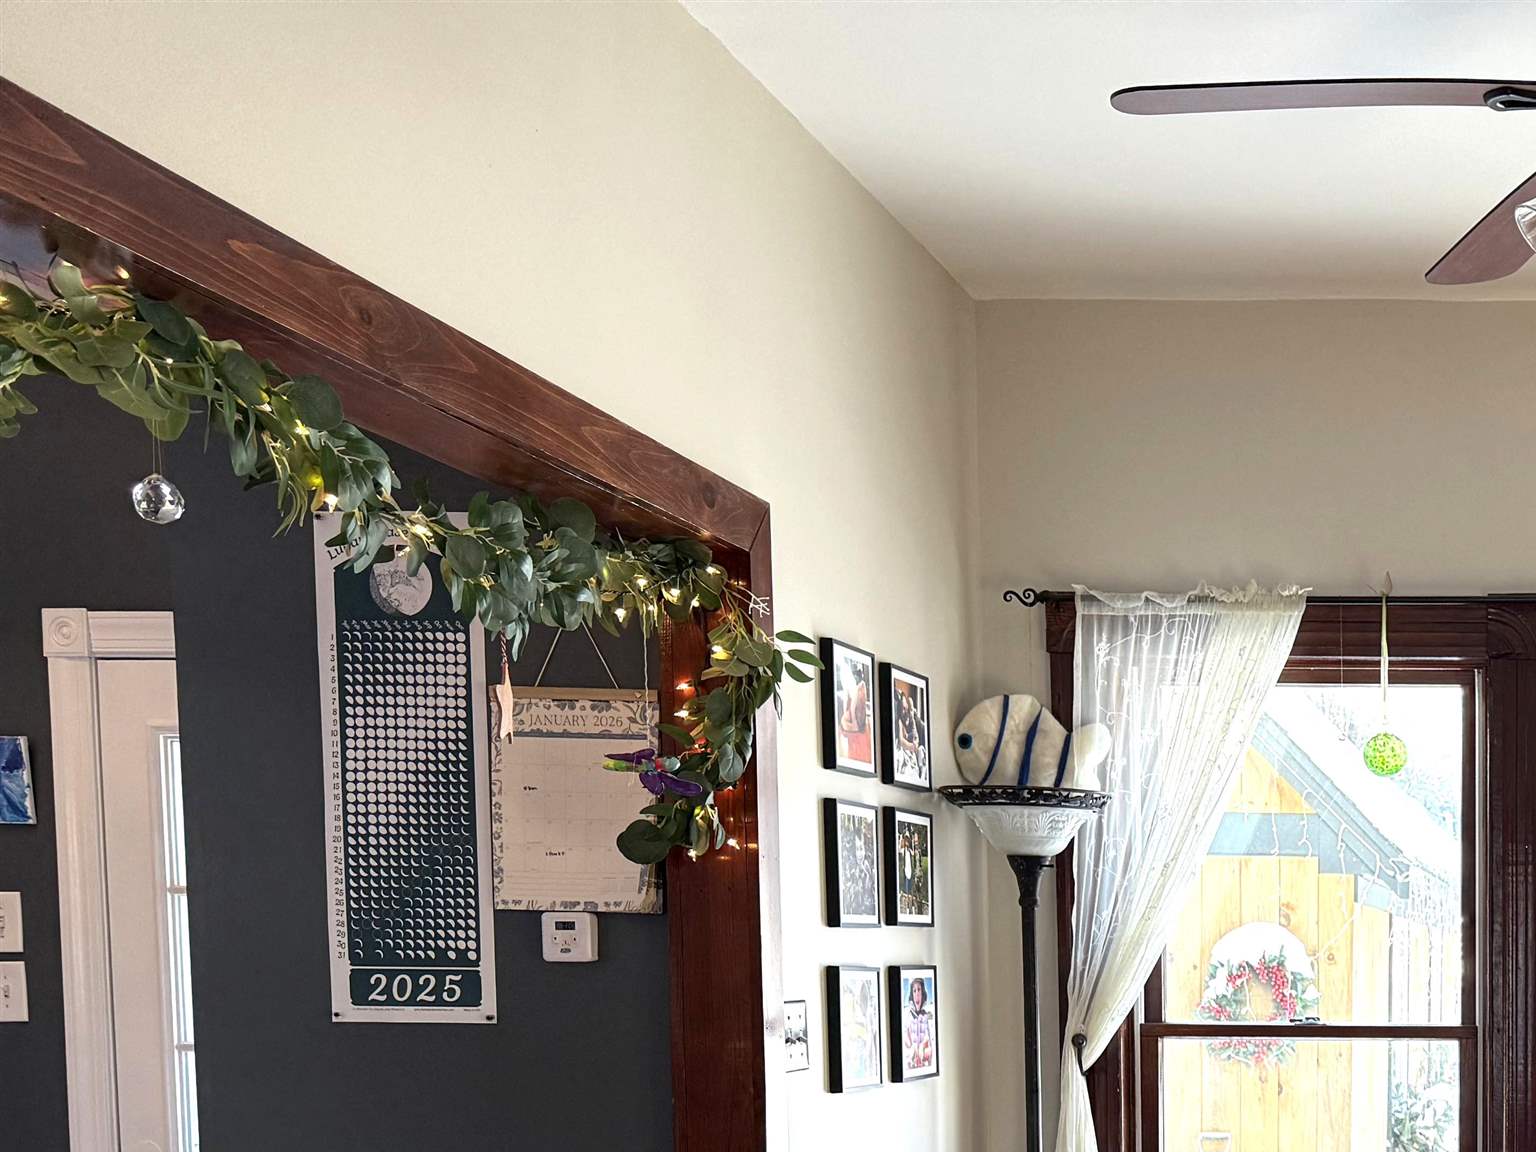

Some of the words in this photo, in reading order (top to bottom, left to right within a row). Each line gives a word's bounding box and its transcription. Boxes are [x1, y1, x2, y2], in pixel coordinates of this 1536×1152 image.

[329, 643, 335, 652] 2
[330, 654, 336, 663] 3
[329, 665, 336, 673] 4
[330, 675, 337, 684] 5
[331, 686, 337, 695] 6
[331, 697, 337, 706] 7
[332, 708, 338, 716] 8
[332, 718, 338, 727] 9
[528, 713, 588, 727] JANUARY
[593, 715, 623, 728] 2026
[330, 729, 339, 737] 10
[331, 740, 339, 748] 11
[331, 750, 339, 759] 12
[332, 761, 340, 769] 13
[332, 771, 340, 780] 14
[333, 782, 340, 790] 15
[333, 793, 341, 801] 16
[333, 803, 341, 812] 17
[334, 814, 342, 822] 18
[334, 825, 342, 833] 19
[332, 835, 342, 843] 20
[334, 877, 344, 885] 24
[335, 898, 345, 907] 26
[335, 919, 345, 928] 28
[336, 929, 346, 939] 29
[337, 951, 346, 959] 31
[368, 973, 462, 1002] 2025
